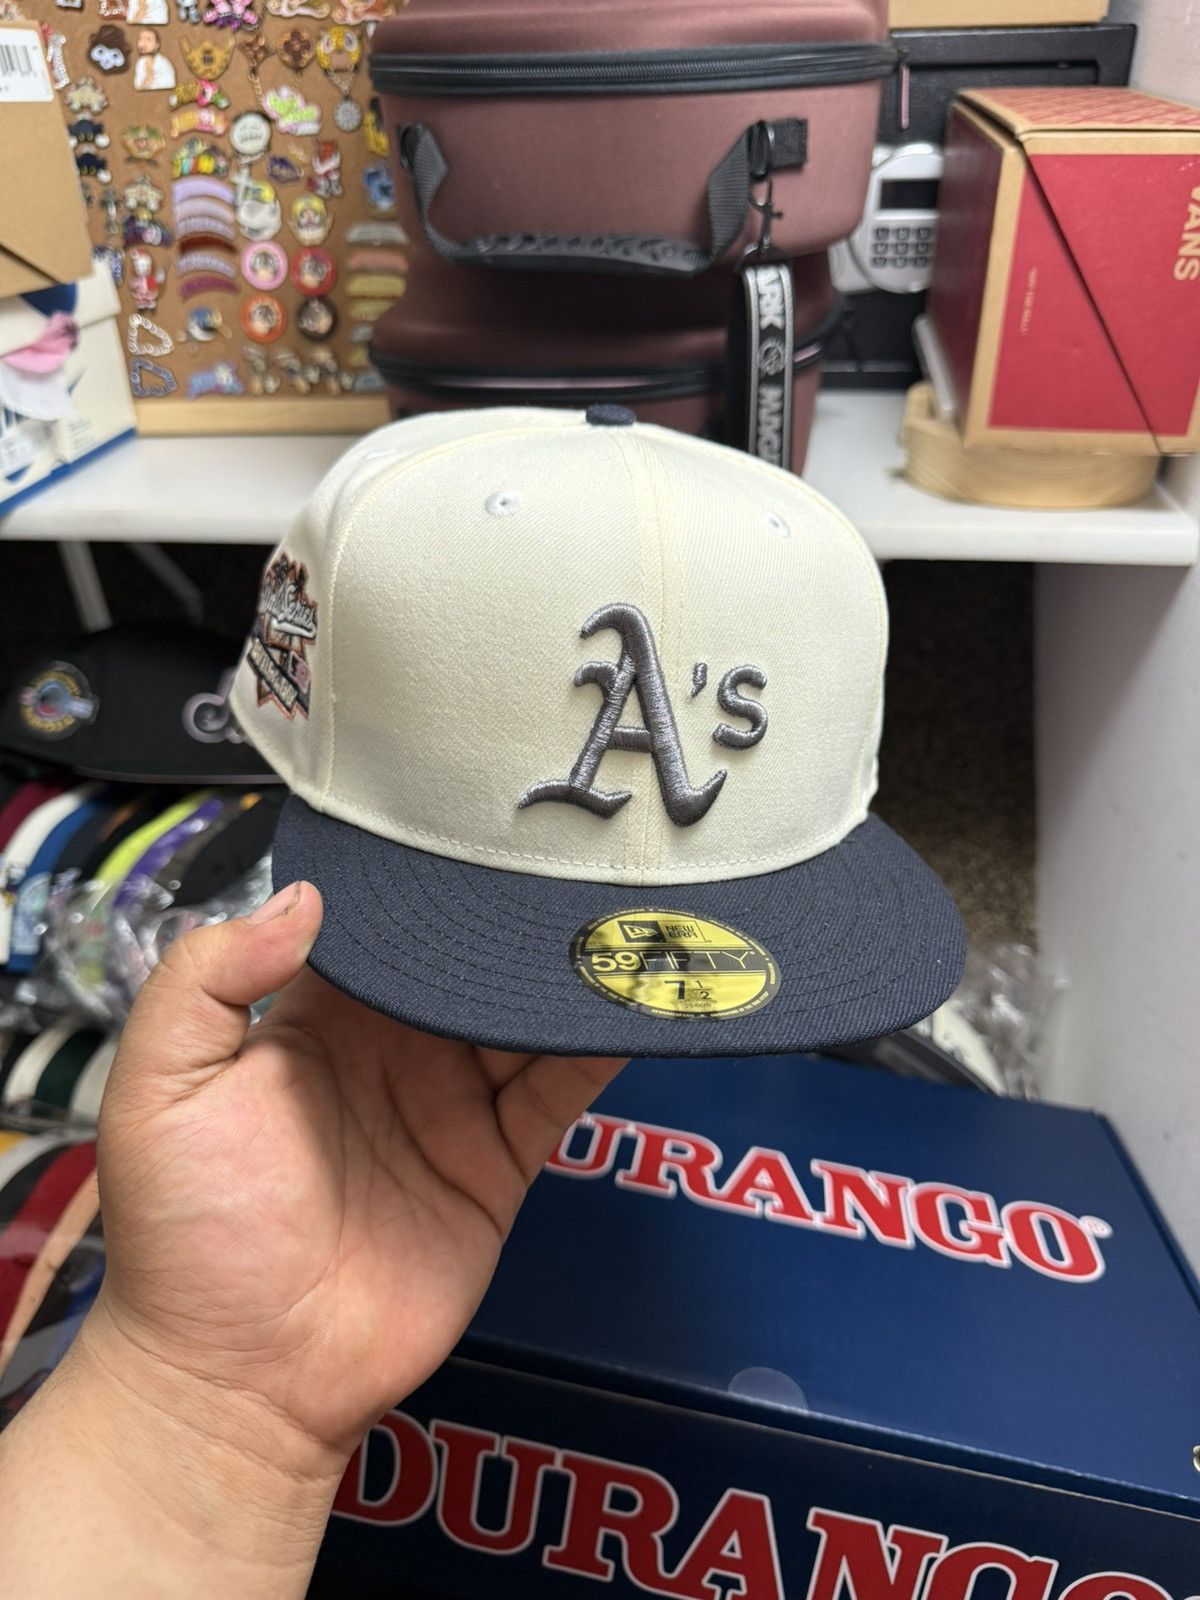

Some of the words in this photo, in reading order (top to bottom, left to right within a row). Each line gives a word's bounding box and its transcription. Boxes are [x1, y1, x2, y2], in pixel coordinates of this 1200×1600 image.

[757, 268, 785, 330] ARK
[518, 602, 768, 827] A's
[664, 924, 694, 932] NEW
[591, 950, 750, 972] 59FIFTY
[545, 1111, 1106, 1284] URANGO
